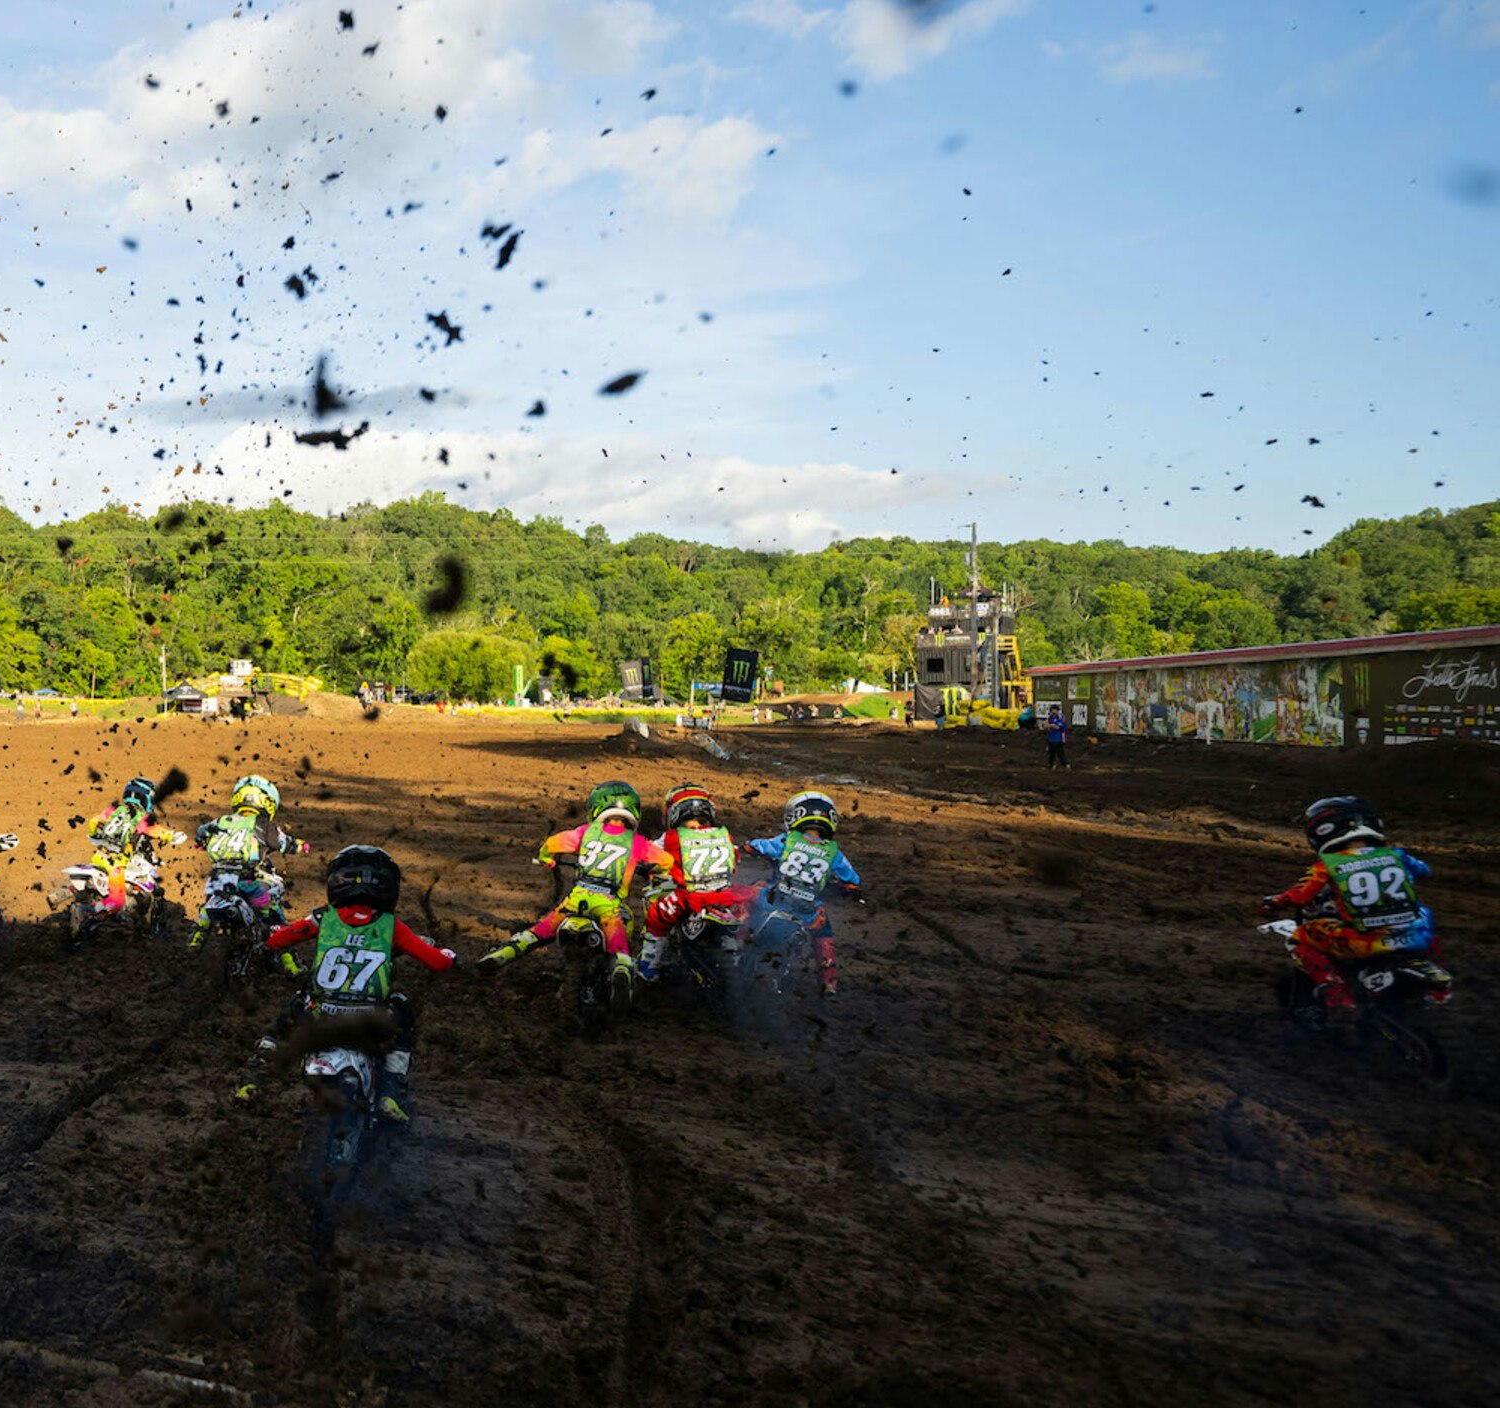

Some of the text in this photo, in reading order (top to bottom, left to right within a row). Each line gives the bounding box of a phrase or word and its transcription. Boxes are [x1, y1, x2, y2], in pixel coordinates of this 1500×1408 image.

[578, 840, 628, 870] 37
[690, 846, 729, 875] 72
[779, 851, 830, 884] 83
[1347, 866, 1408, 907] 92
[346, 933, 366, 947] LEE
[316, 947, 387, 992] 67
